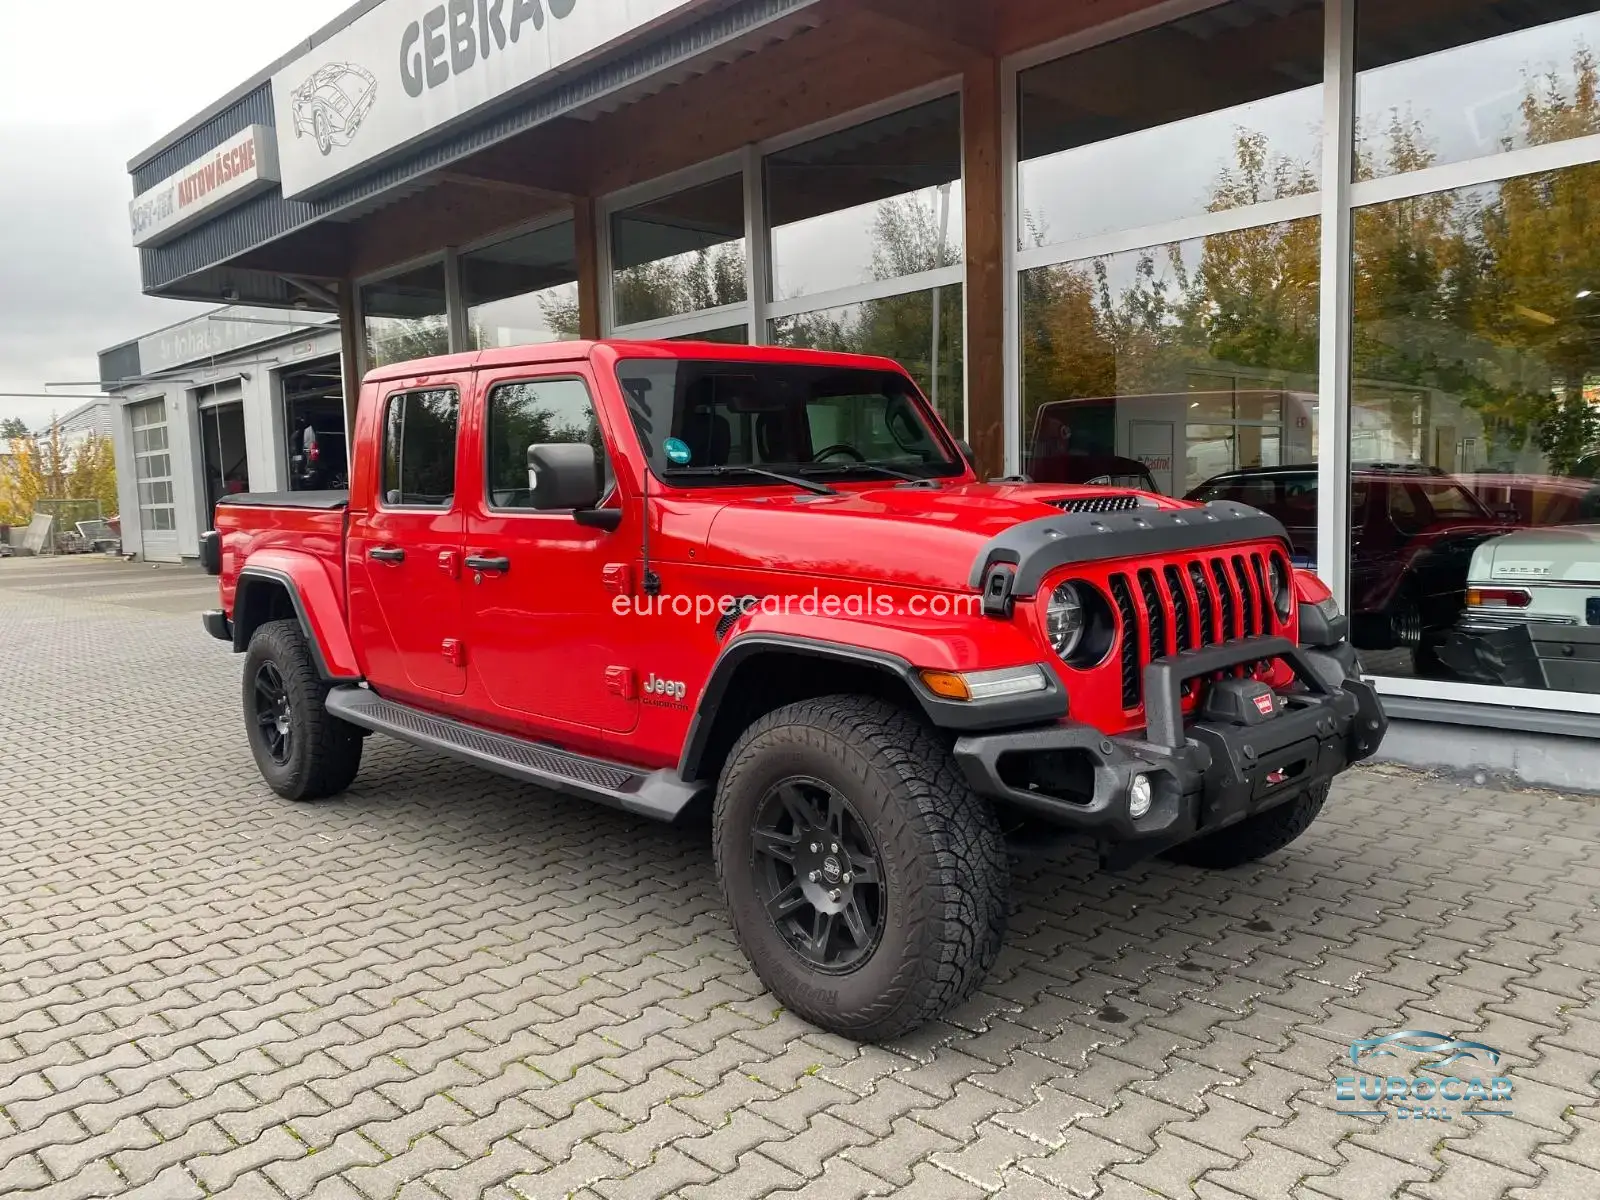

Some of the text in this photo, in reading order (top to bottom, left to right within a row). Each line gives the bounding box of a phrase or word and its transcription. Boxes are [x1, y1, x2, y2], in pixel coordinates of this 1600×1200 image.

[400, 0, 577, 97] GEBRA
[177, 138, 256, 209] AUTOWÄSCHE
[643, 672, 686, 701] Jeep
